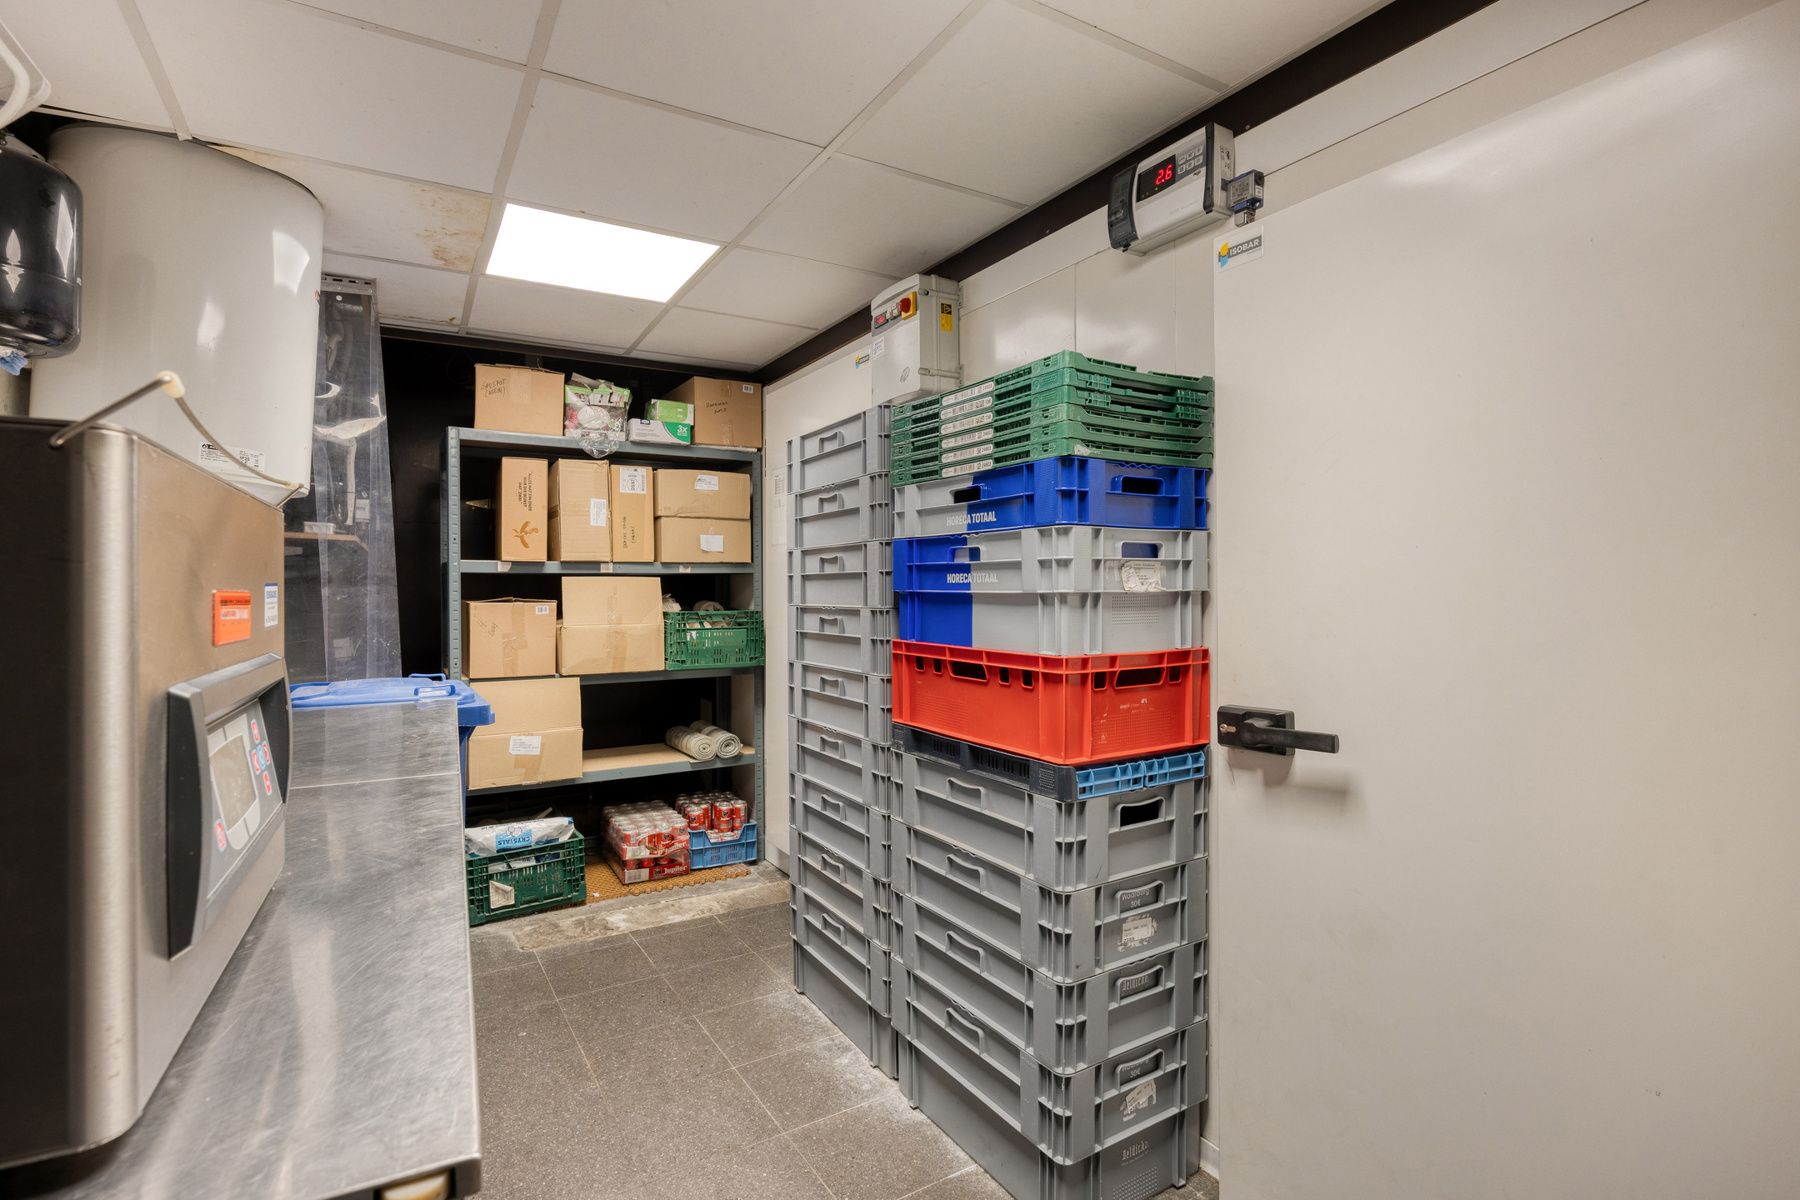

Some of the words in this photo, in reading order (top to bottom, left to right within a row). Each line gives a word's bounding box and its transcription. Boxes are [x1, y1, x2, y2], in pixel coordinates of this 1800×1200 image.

[1154, 164, 1173, 185] 2.6
[1230, 239, 1260, 256] ISOBAR
[946, 514, 971, 526] HORECA
[972, 510, 997, 524] TOTAAL
[946, 573, 972, 584] HORECA
[972, 572, 999, 583] TOTAAL
[497, 836, 530, 846] CRYSTALS
[664, 865, 688, 874] Jupiler
